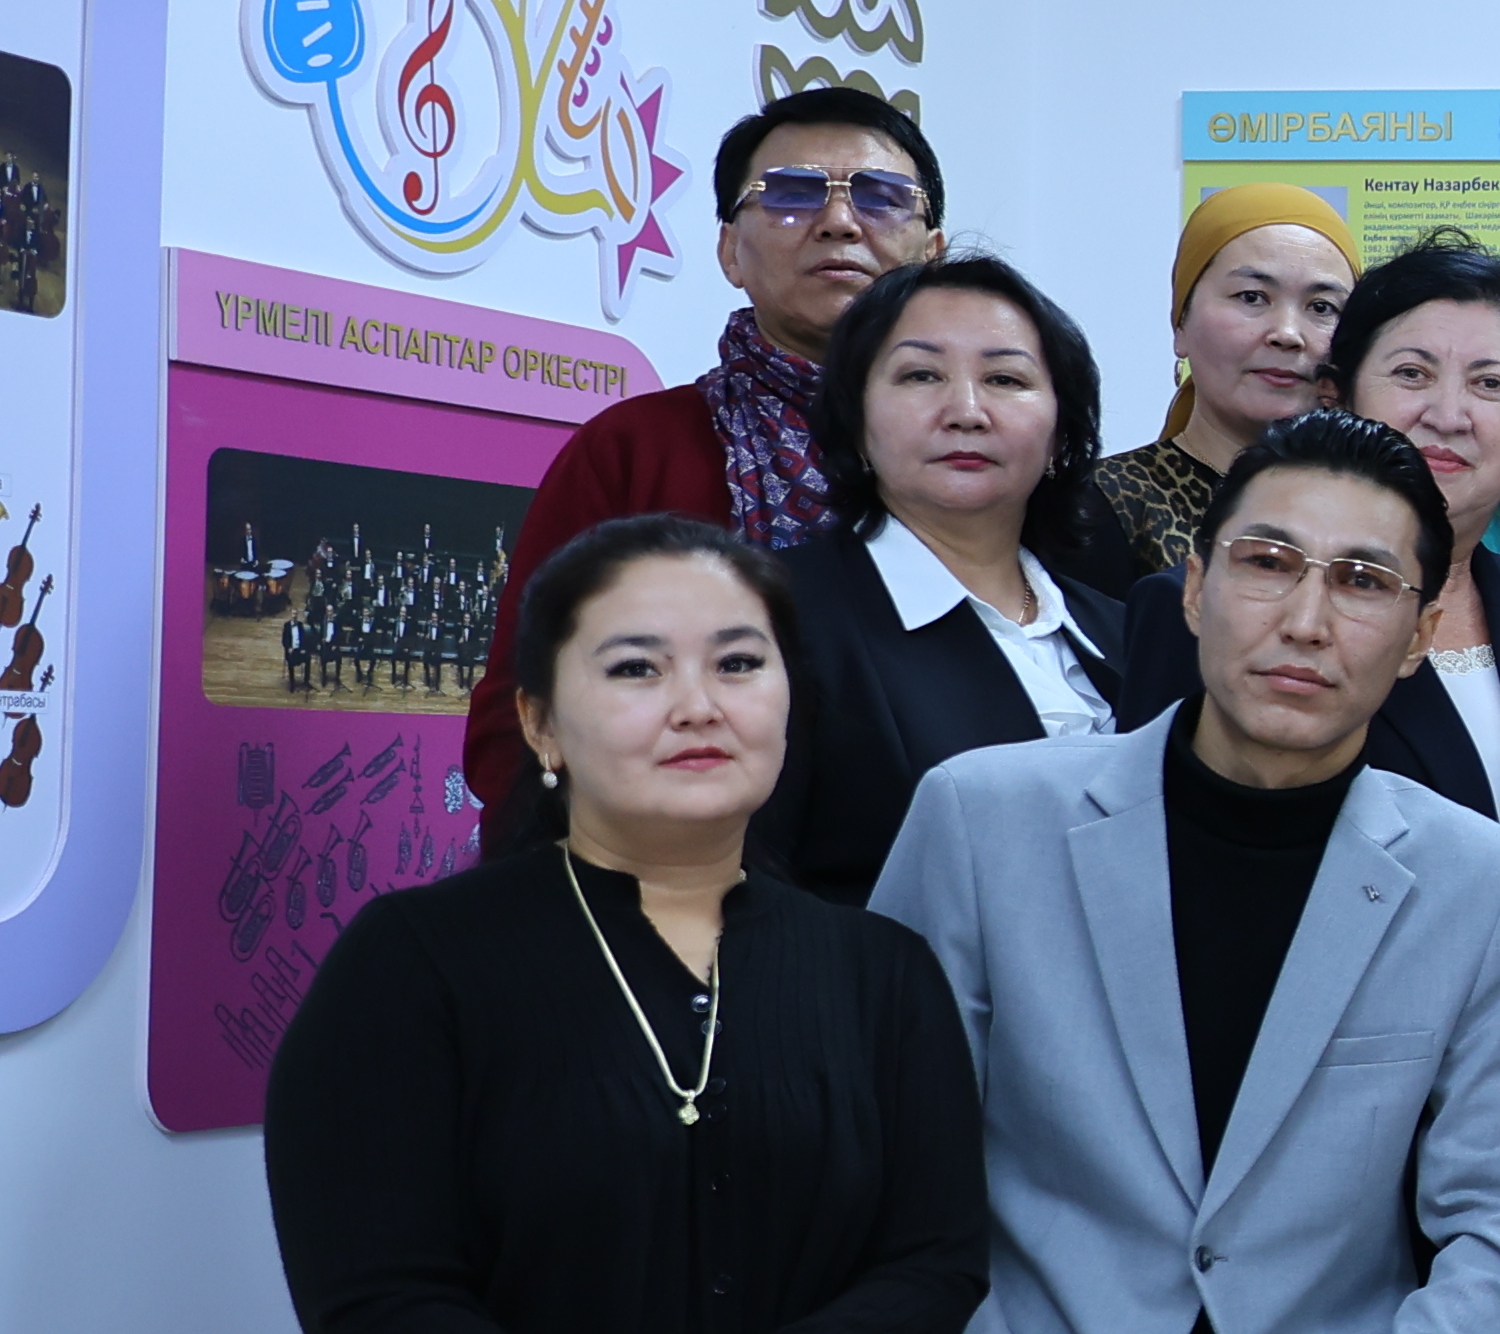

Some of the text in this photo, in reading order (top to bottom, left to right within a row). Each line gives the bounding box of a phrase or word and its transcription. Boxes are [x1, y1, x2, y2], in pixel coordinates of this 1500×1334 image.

[1208, 111, 1453, 143] ӨМІРБАЯНЫ
[1364, 177, 1419, 195] Кентау
[1423, 176, 1500, 195] Назарбек
[215, 290, 628, 398] ҮРМЕЛІ АСПАПТАР ОРКЕСТРІ
